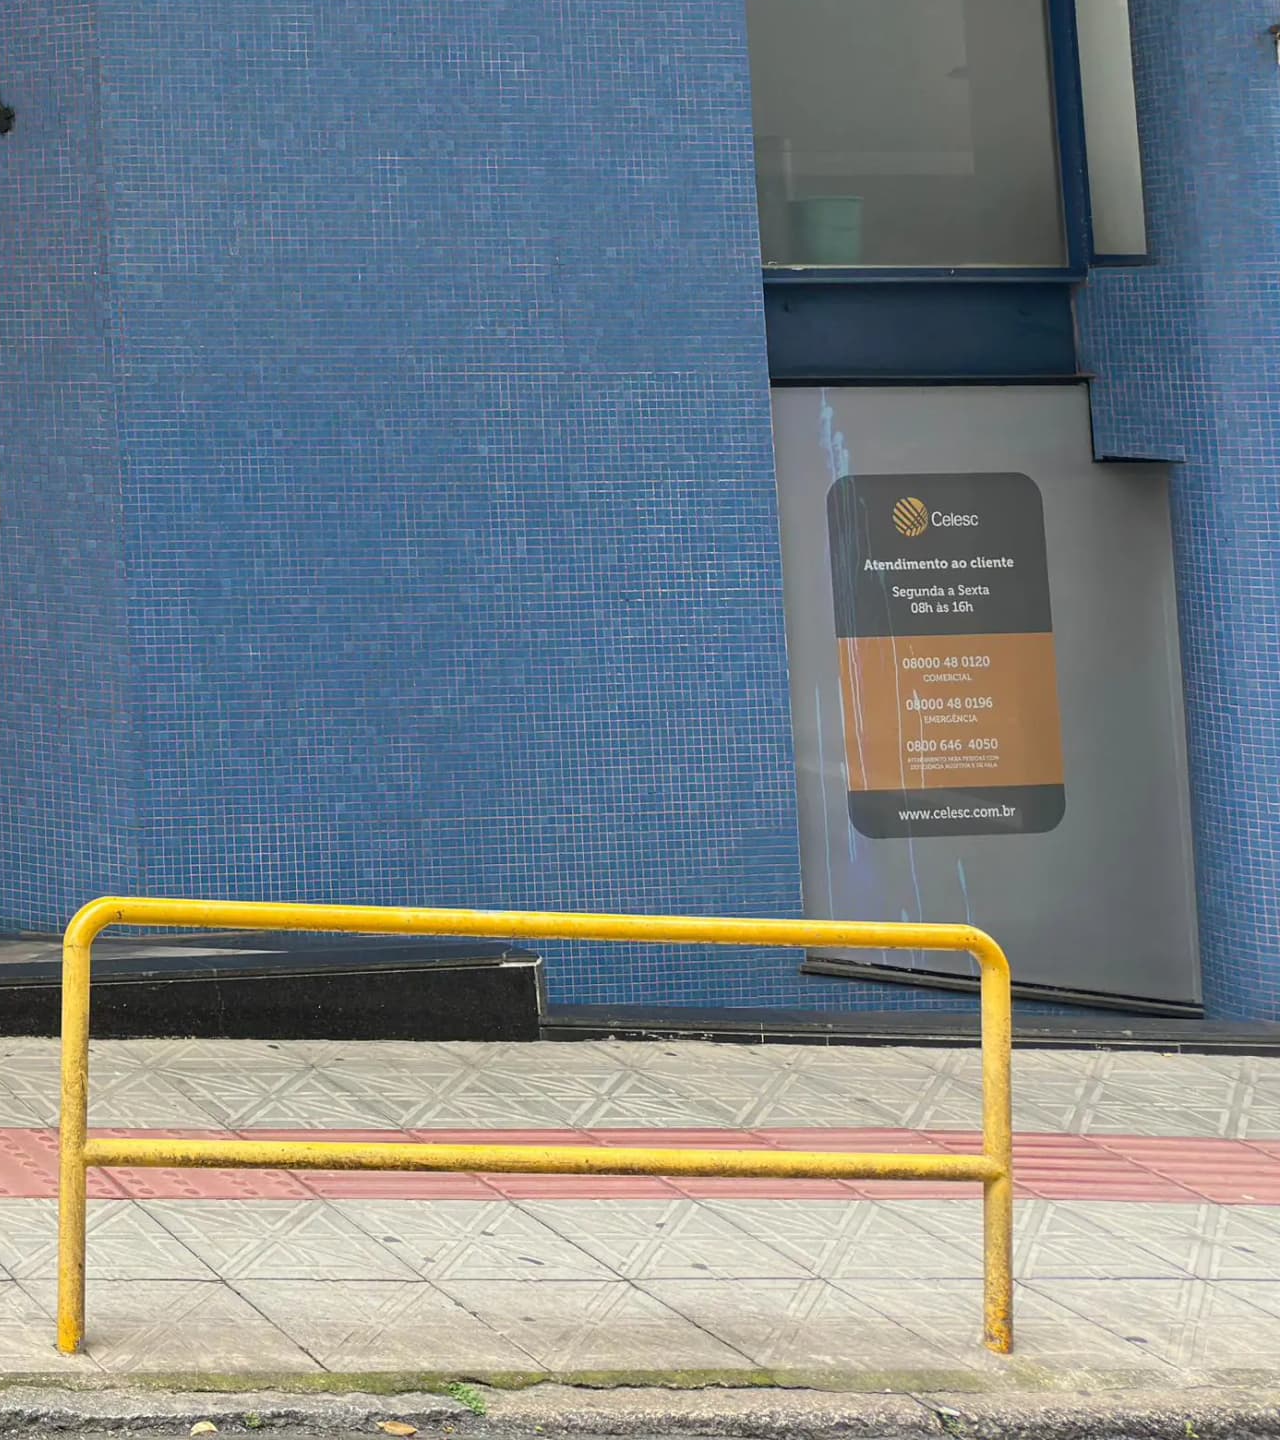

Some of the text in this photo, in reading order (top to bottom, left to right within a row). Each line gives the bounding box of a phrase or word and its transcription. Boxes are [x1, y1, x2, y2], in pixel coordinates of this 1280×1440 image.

[931, 511, 979, 527] Celesc
[864, 557, 1014, 571] Atendimento ao cliente
[892, 584, 990, 599] Segunda a Sexta
[911, 602, 933, 613] 08h
[952, 601, 974, 613] 16h
[903, 655, 991, 669] 08000 48 0120
[923, 673, 972, 682] COMERCIAL
[947, 698, 961, 709] 48
[964, 697, 993, 709] 0196
[906, 738, 998, 752] 0800 646 4050
[899, 805, 1016, 821] www.celesc.com.br
